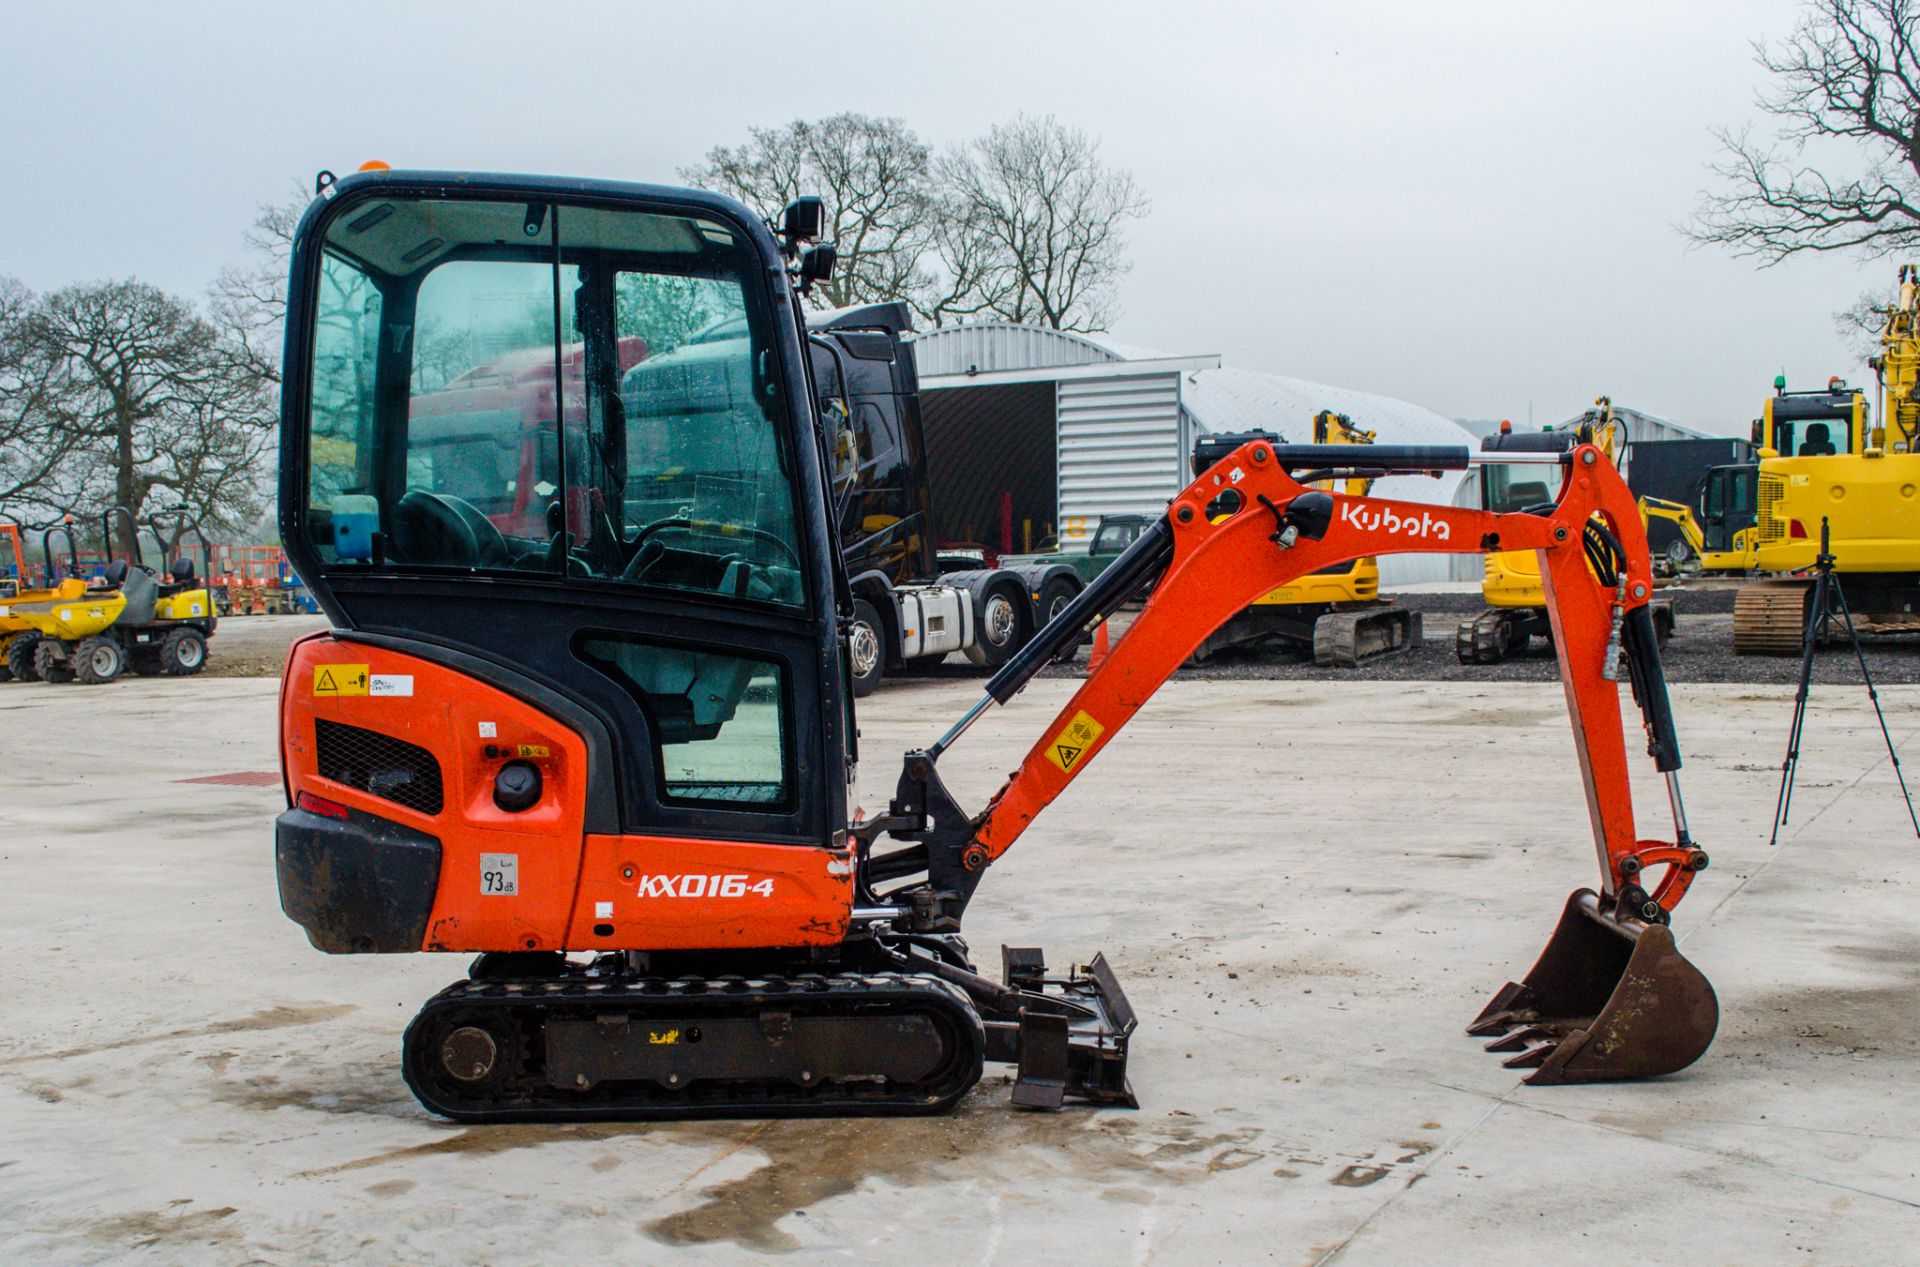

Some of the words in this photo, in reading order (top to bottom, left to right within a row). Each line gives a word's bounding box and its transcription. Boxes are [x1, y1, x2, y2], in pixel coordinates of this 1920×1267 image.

[1067, 515, 1087, 539] 8
[1341, 502, 1450, 540] Kubota
[484, 871, 503, 892] 93
[503, 881, 514, 892] dB
[637, 874, 774, 897] KX016-4
